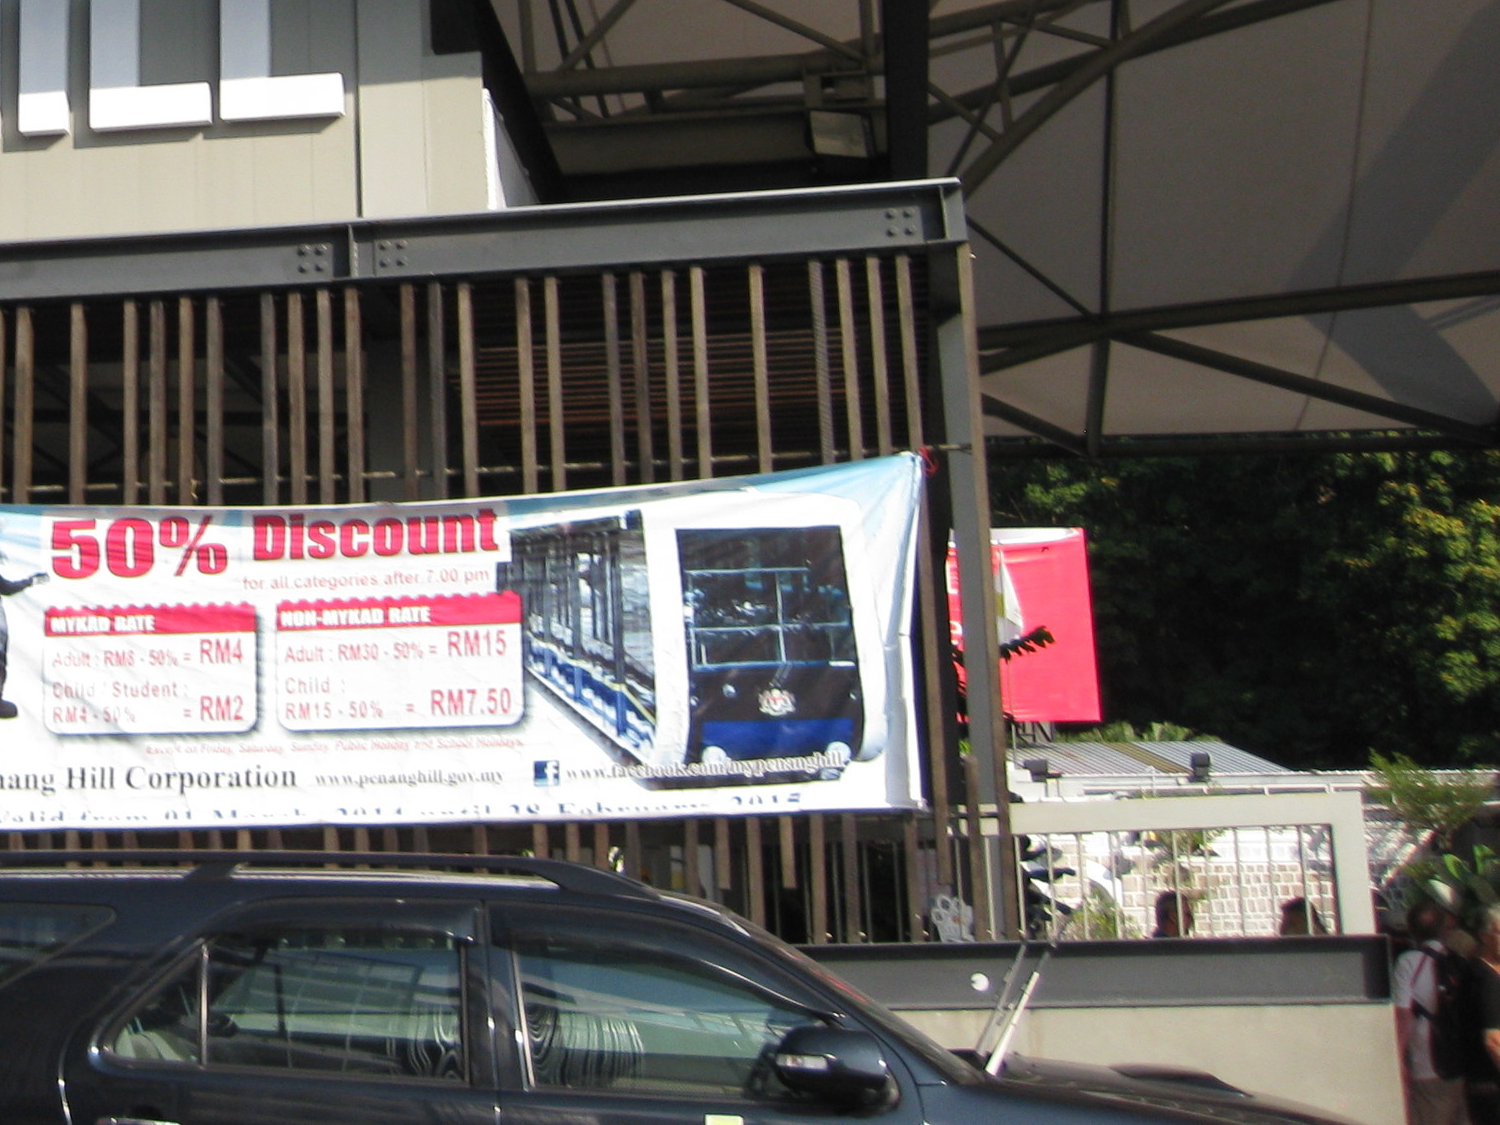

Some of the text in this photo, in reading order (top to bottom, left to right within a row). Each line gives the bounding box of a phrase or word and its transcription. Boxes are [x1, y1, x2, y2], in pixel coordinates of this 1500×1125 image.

[51, 509, 499, 580] 50% Discount
[243, 576, 265, 591] for
[293, 573, 378, 593] categories
[383, 570, 419, 586] after
[426, 568, 459, 584] 7.00
[464, 569, 490, 586] pm
[50, 614, 156, 633] MYKAD RATE
[280, 606, 432, 627] NON-MYKAD RATE
[200, 638, 244, 665] RM4
[285, 645, 325, 663] Adult
[338, 643, 380, 662] RM30
[393, 641, 424, 660] 50%
[448, 629, 508, 658] RM15
[112, 680, 178, 699] Student
[285, 677, 332, 695] Child
[200, 695, 244, 722] RM2
[285, 702, 333, 721] RM15
[348, 700, 384, 719] 50%
[430, 687, 512, 717] RM7.50
[66, 765, 116, 791] Hill
[125, 764, 299, 796] Corporation
